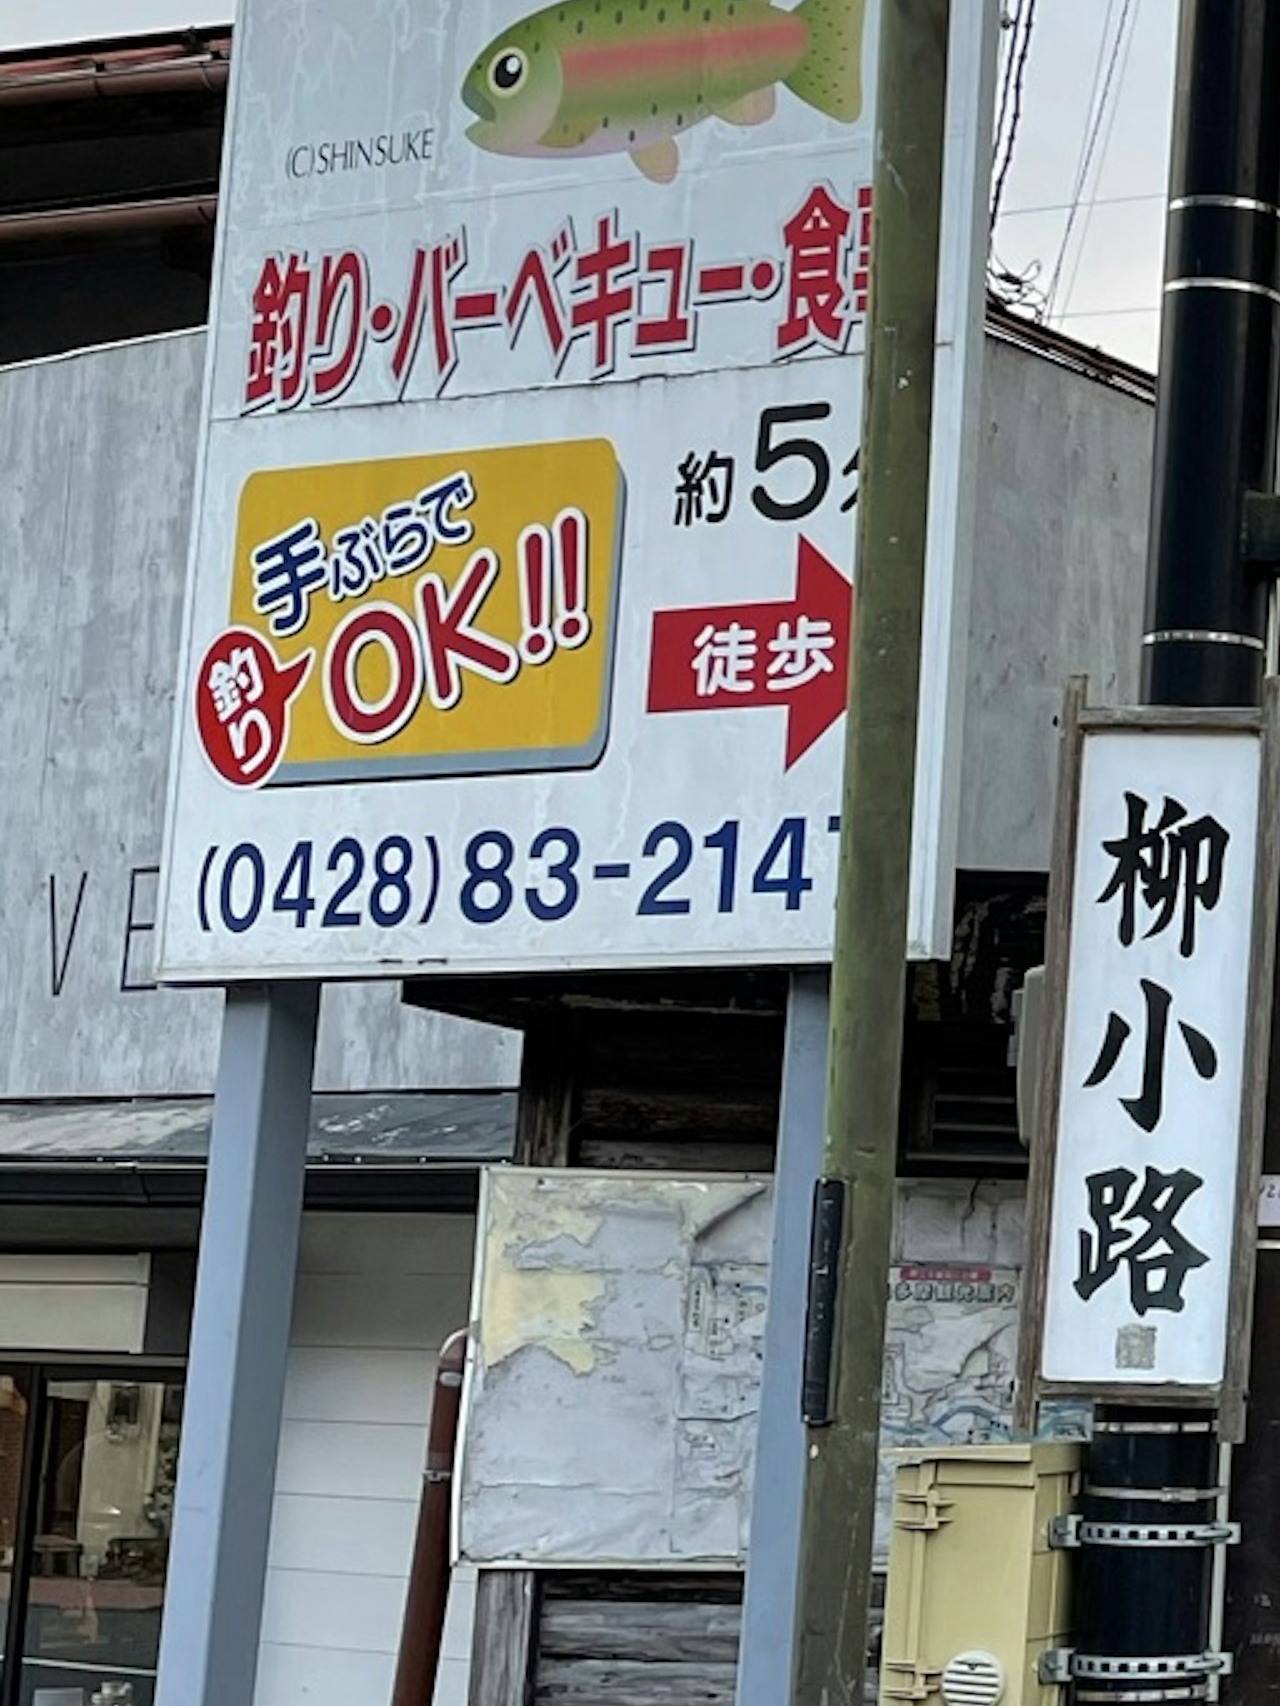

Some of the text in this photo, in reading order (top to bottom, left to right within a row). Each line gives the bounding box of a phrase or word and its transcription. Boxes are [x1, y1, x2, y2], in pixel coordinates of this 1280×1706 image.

[286, 128, 434, 178] (C)SHINSUKE
[244, 183, 872, 409] 釣り・バーベキュー・食
[674, 402, 860, 527] 約5
[254, 475, 474, 631] 手ぶらで
[207, 655, 266, 775] 釣り
[692, 616, 834, 694] 徒歩
[1072, 790, 1231, 1317] 柳小路
